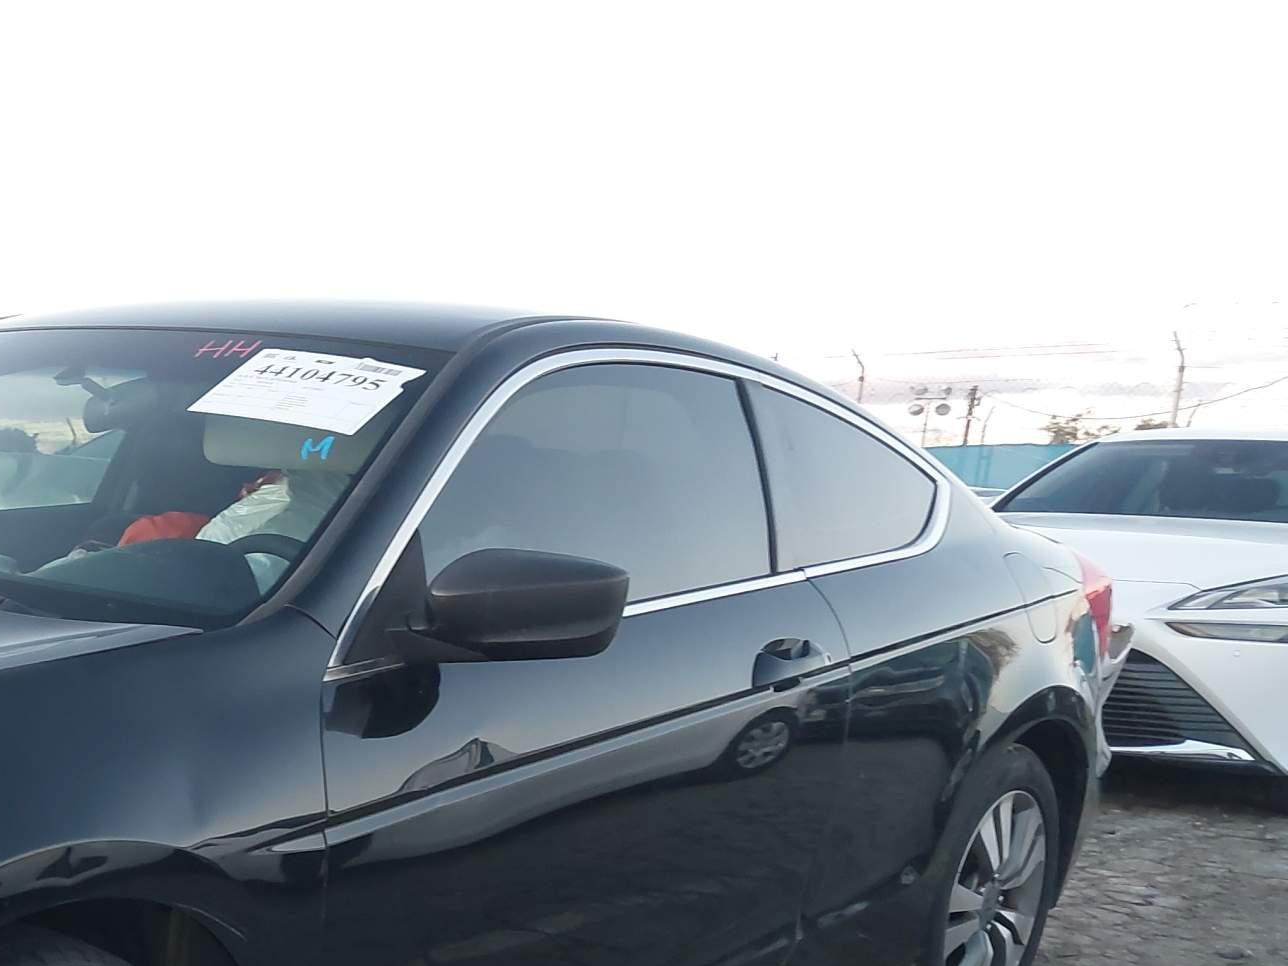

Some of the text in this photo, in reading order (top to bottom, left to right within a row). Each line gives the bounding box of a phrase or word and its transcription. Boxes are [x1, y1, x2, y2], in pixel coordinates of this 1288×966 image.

[194, 340, 262, 359] HH
[253, 363, 388, 392] 44104795
[300, 435, 335, 461] M
